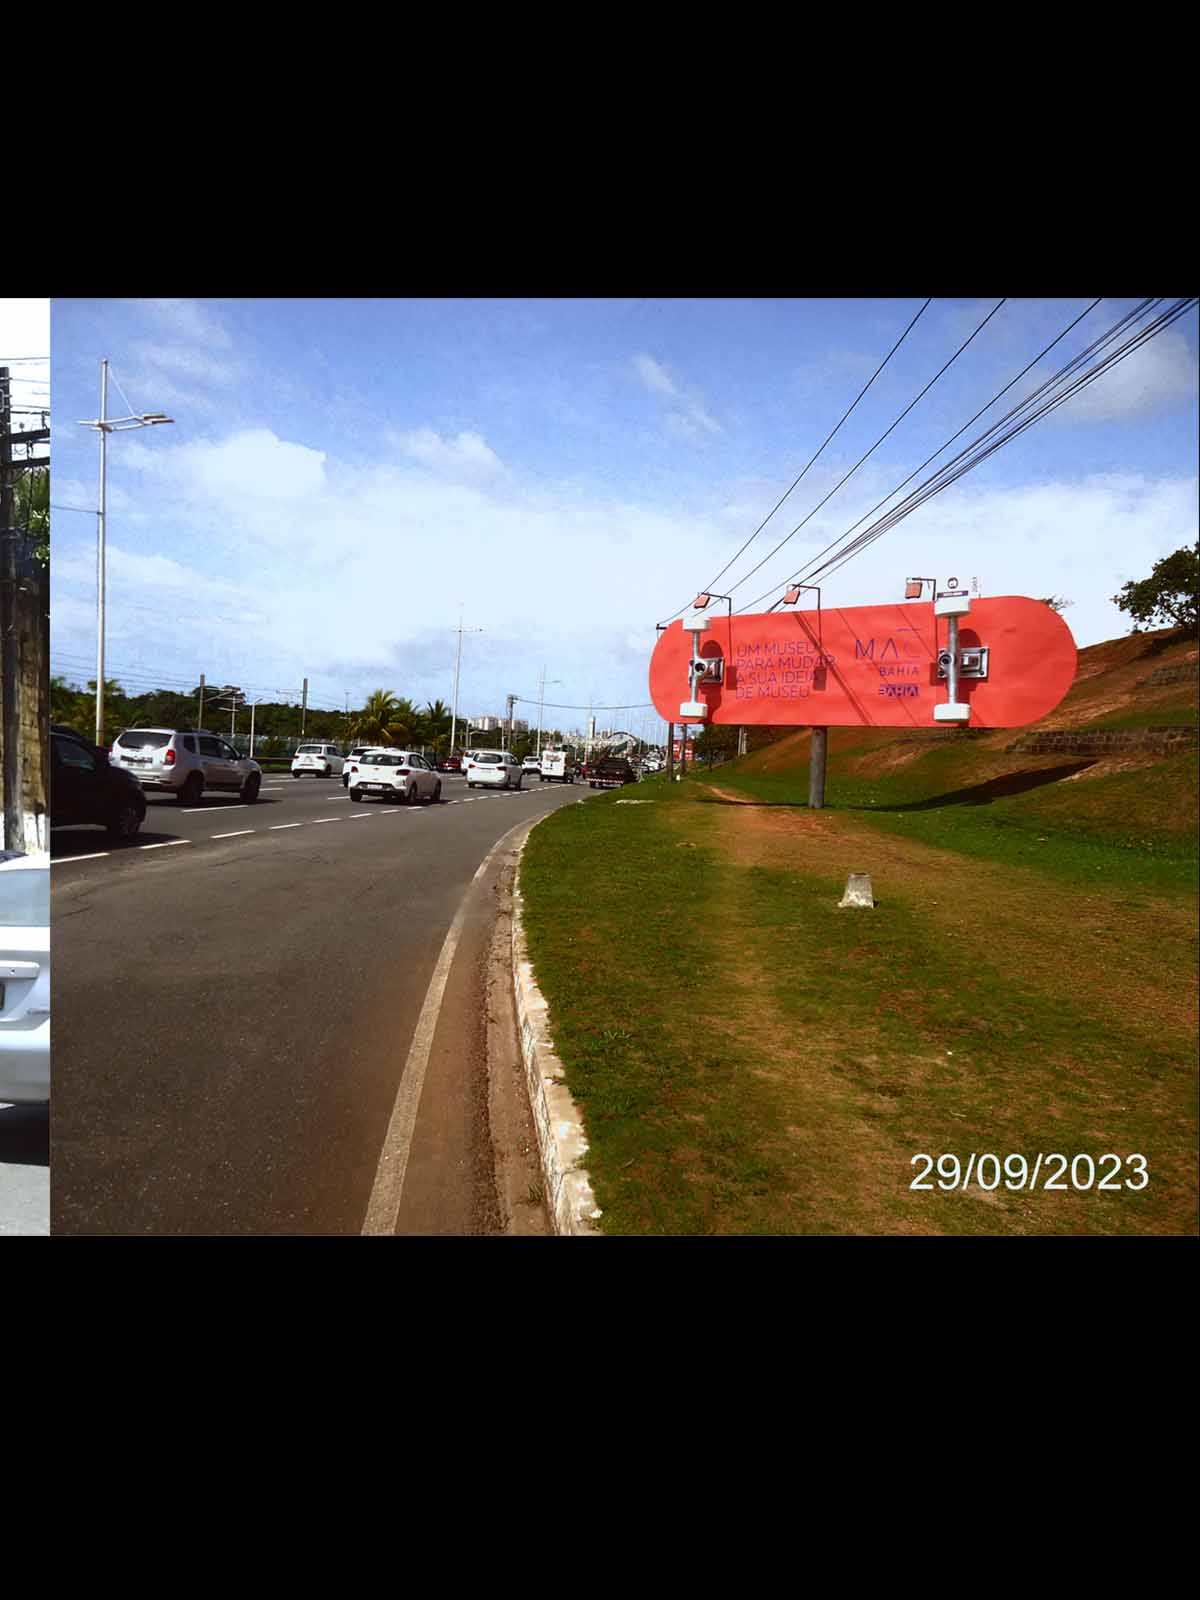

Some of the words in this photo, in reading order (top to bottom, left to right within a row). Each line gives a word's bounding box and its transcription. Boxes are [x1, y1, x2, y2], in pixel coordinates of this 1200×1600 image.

[737, 643, 760, 658] UM
[764, 640, 818, 657] MUSEU
[737, 656, 774, 671] PARA
[778, 653, 836, 670] MUDAR
[737, 671, 745, 684] A
[748, 670, 777, 685] SUA
[781, 669, 819, 685] IDEIA
[879, 665, 919, 677] BAHIA
[736, 685, 754, 700] DE
